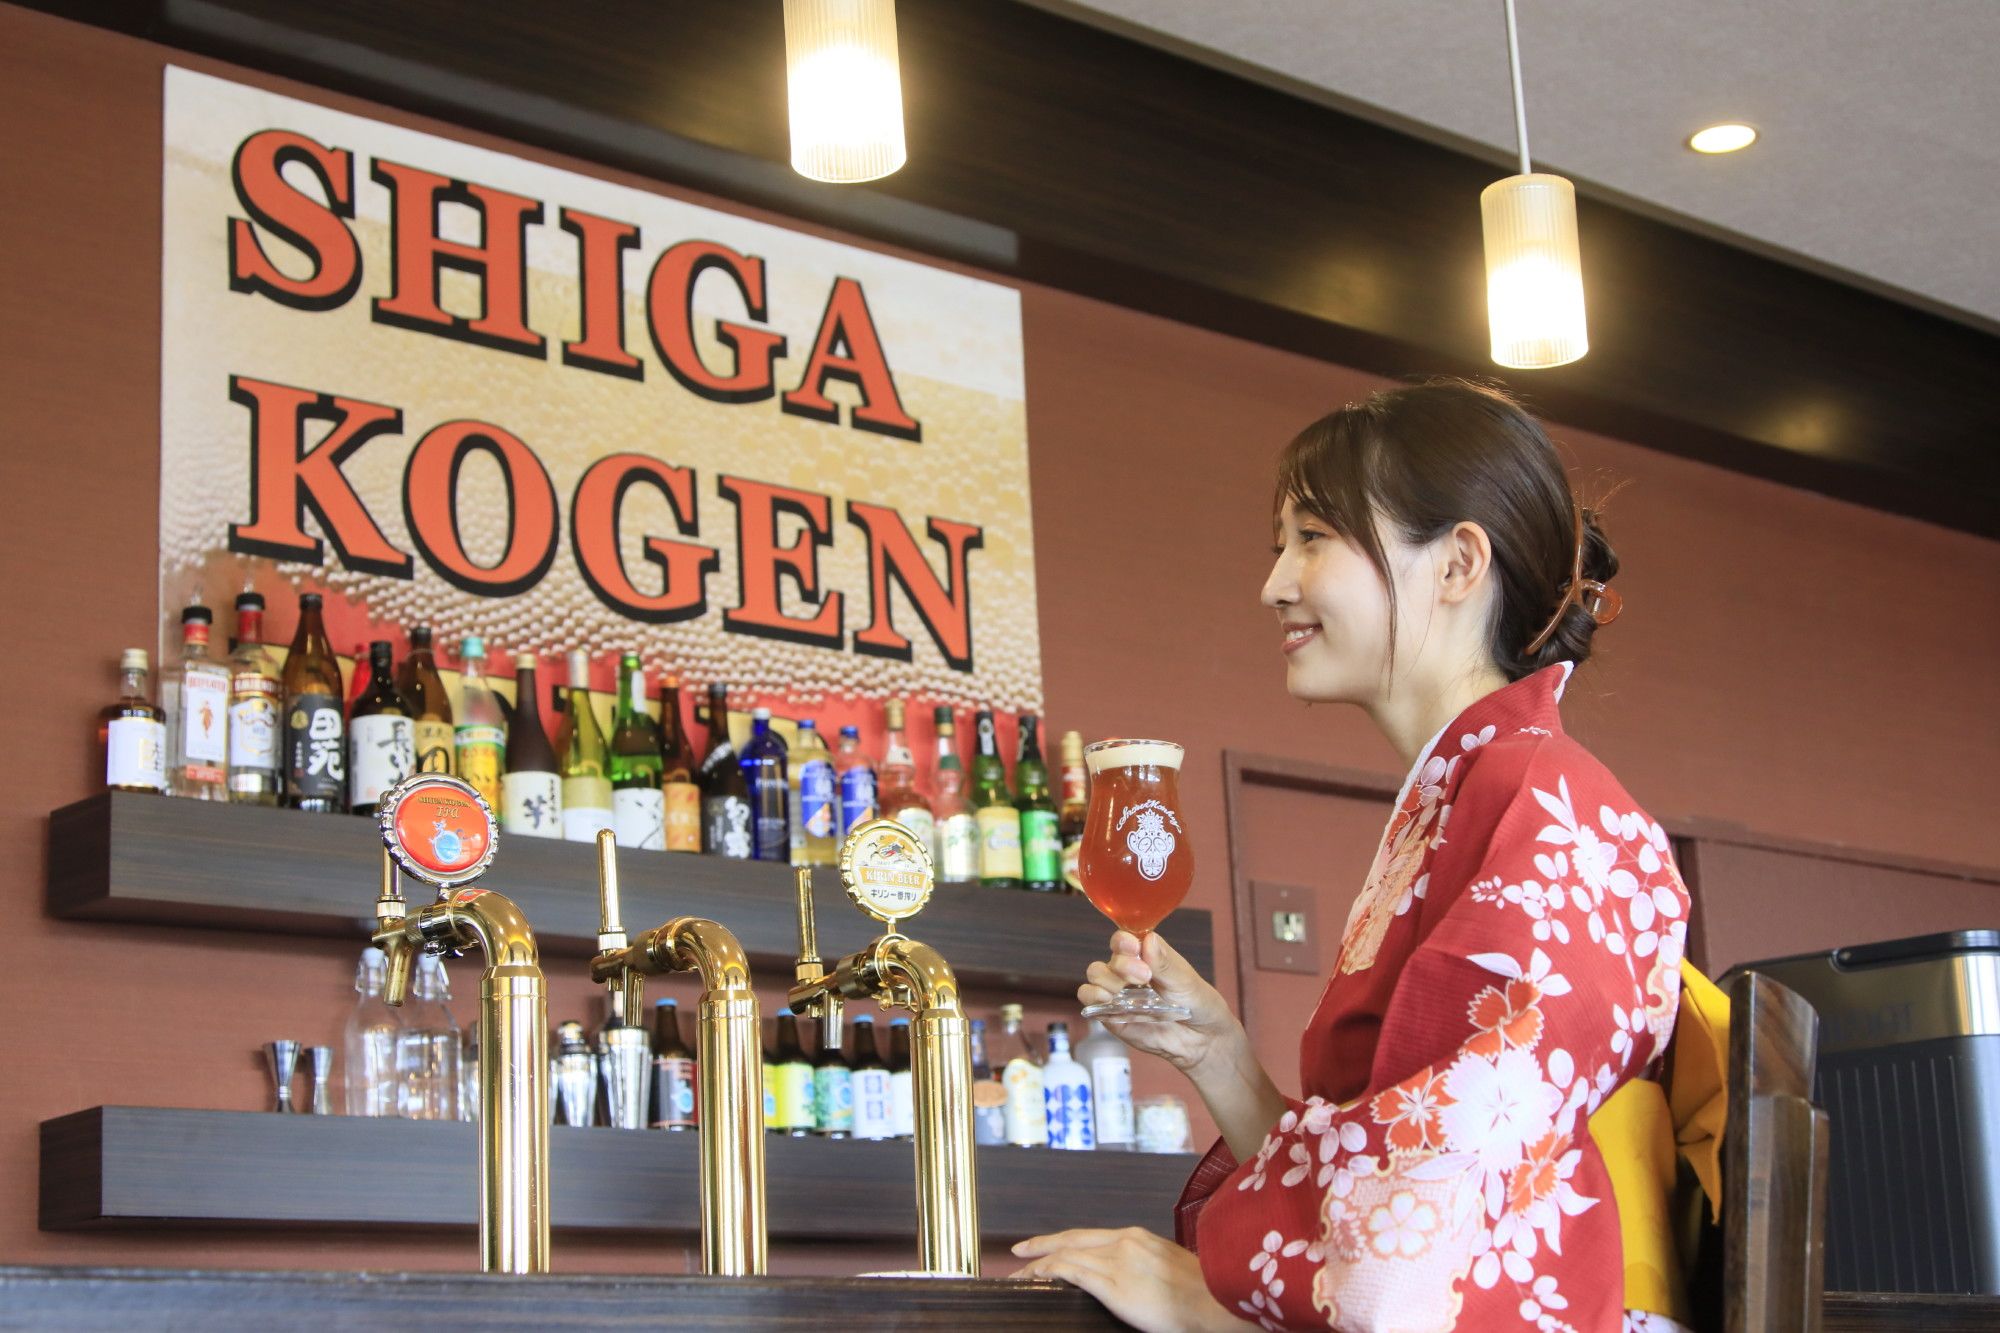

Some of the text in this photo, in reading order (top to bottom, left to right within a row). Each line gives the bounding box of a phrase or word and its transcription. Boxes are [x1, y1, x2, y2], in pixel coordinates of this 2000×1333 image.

[228, 129, 922, 442] SHIGA
[228, 374, 984, 672] KOGEN
[865, 869, 920, 886] KIRIN BEER
